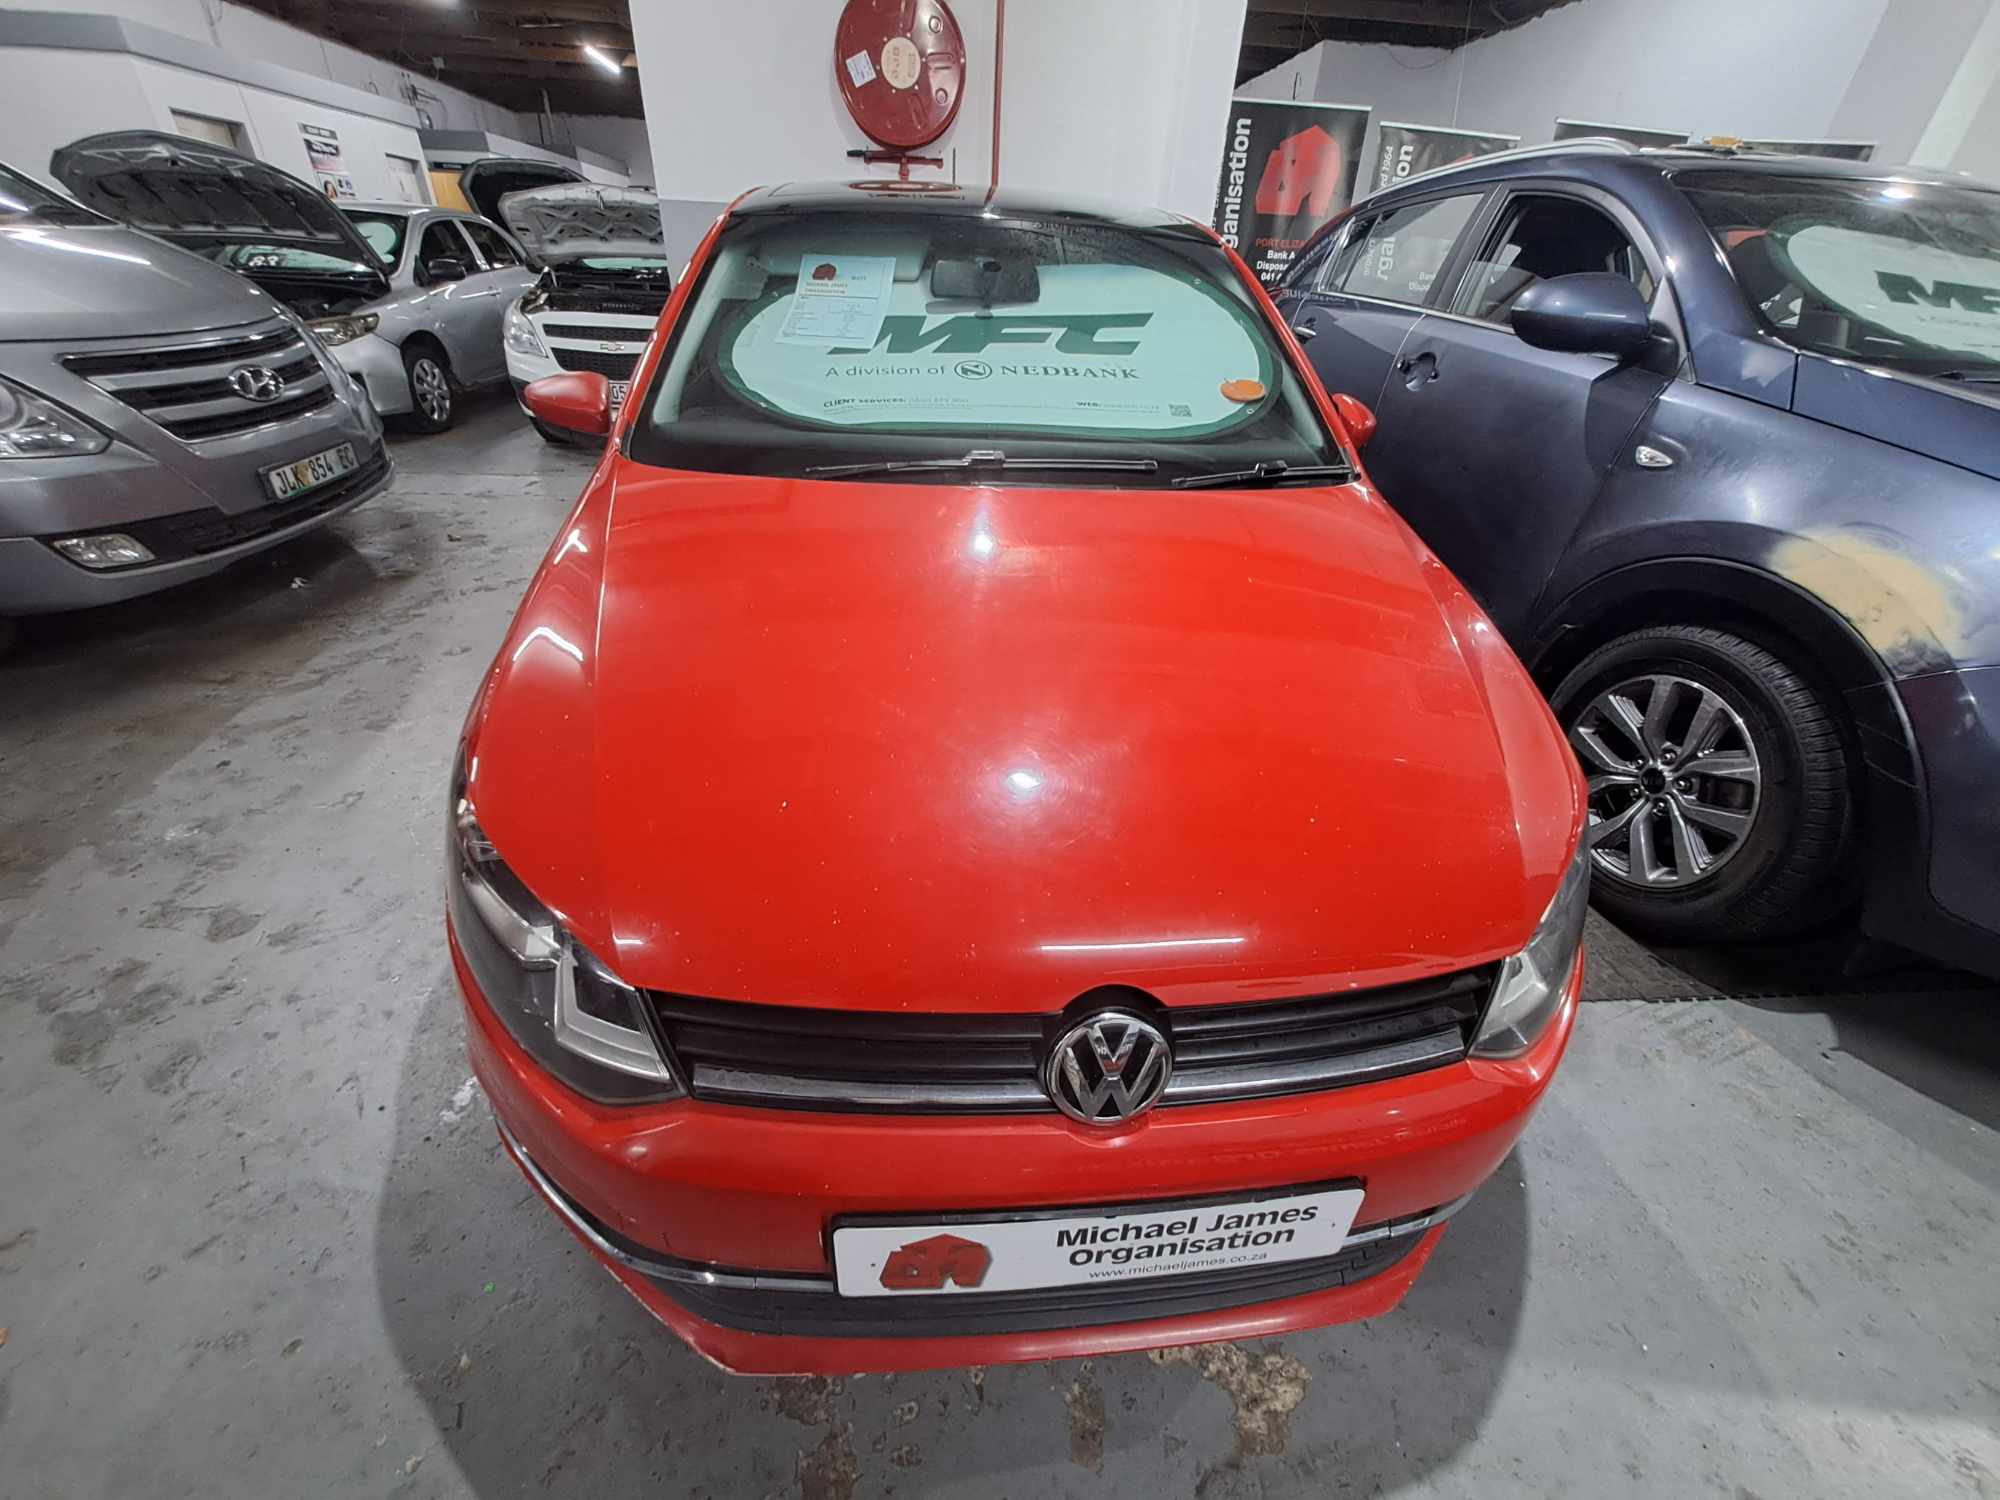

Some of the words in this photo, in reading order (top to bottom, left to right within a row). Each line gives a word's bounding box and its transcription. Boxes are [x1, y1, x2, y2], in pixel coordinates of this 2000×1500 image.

[1382, 146, 1393, 170] 1964
[1267, 250, 1287, 260] Bank
[826, 312, 1154, 356] MFC
[825, 366, 839, 377] A
[846, 364, 920, 377] division
[927, 364, 945, 376] of
[1001, 365, 1140, 379] NEDBANK
[275, 465, 305, 496] JLK
[308, 454, 335, 481] 854
[336, 446, 354, 470] EC
[1056, 1215, 1198, 1248] Michael
[1205, 1205, 1319, 1232] James
[1069, 1227, 1295, 1266] Organisation
[1089, 1252, 1268, 1279] www.michaeljames.co.za
